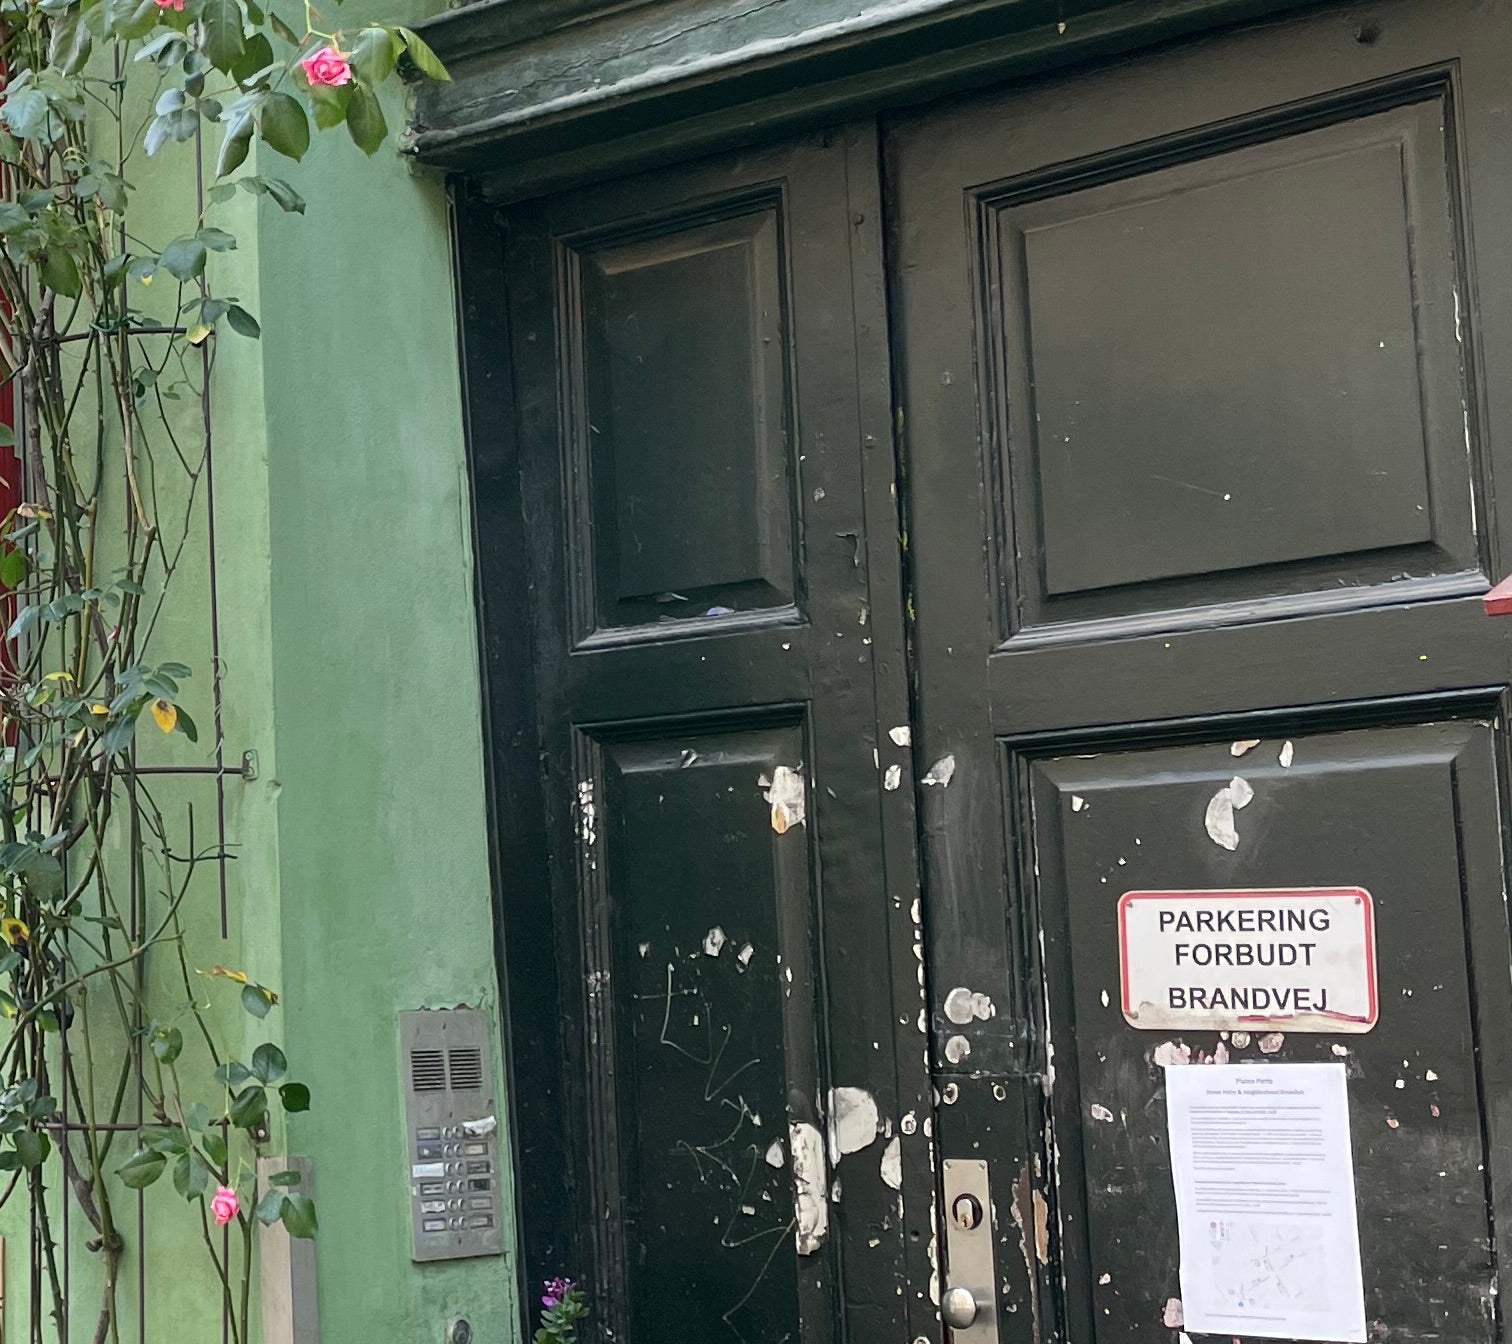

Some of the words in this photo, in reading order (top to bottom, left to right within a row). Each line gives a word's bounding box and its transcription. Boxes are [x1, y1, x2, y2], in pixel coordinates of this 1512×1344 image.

[1159, 908, 1331, 933] PARKERING
[1174, 942, 1317, 967] FORBUDT
[1168, 986, 1329, 1013] BRANDVEJ
